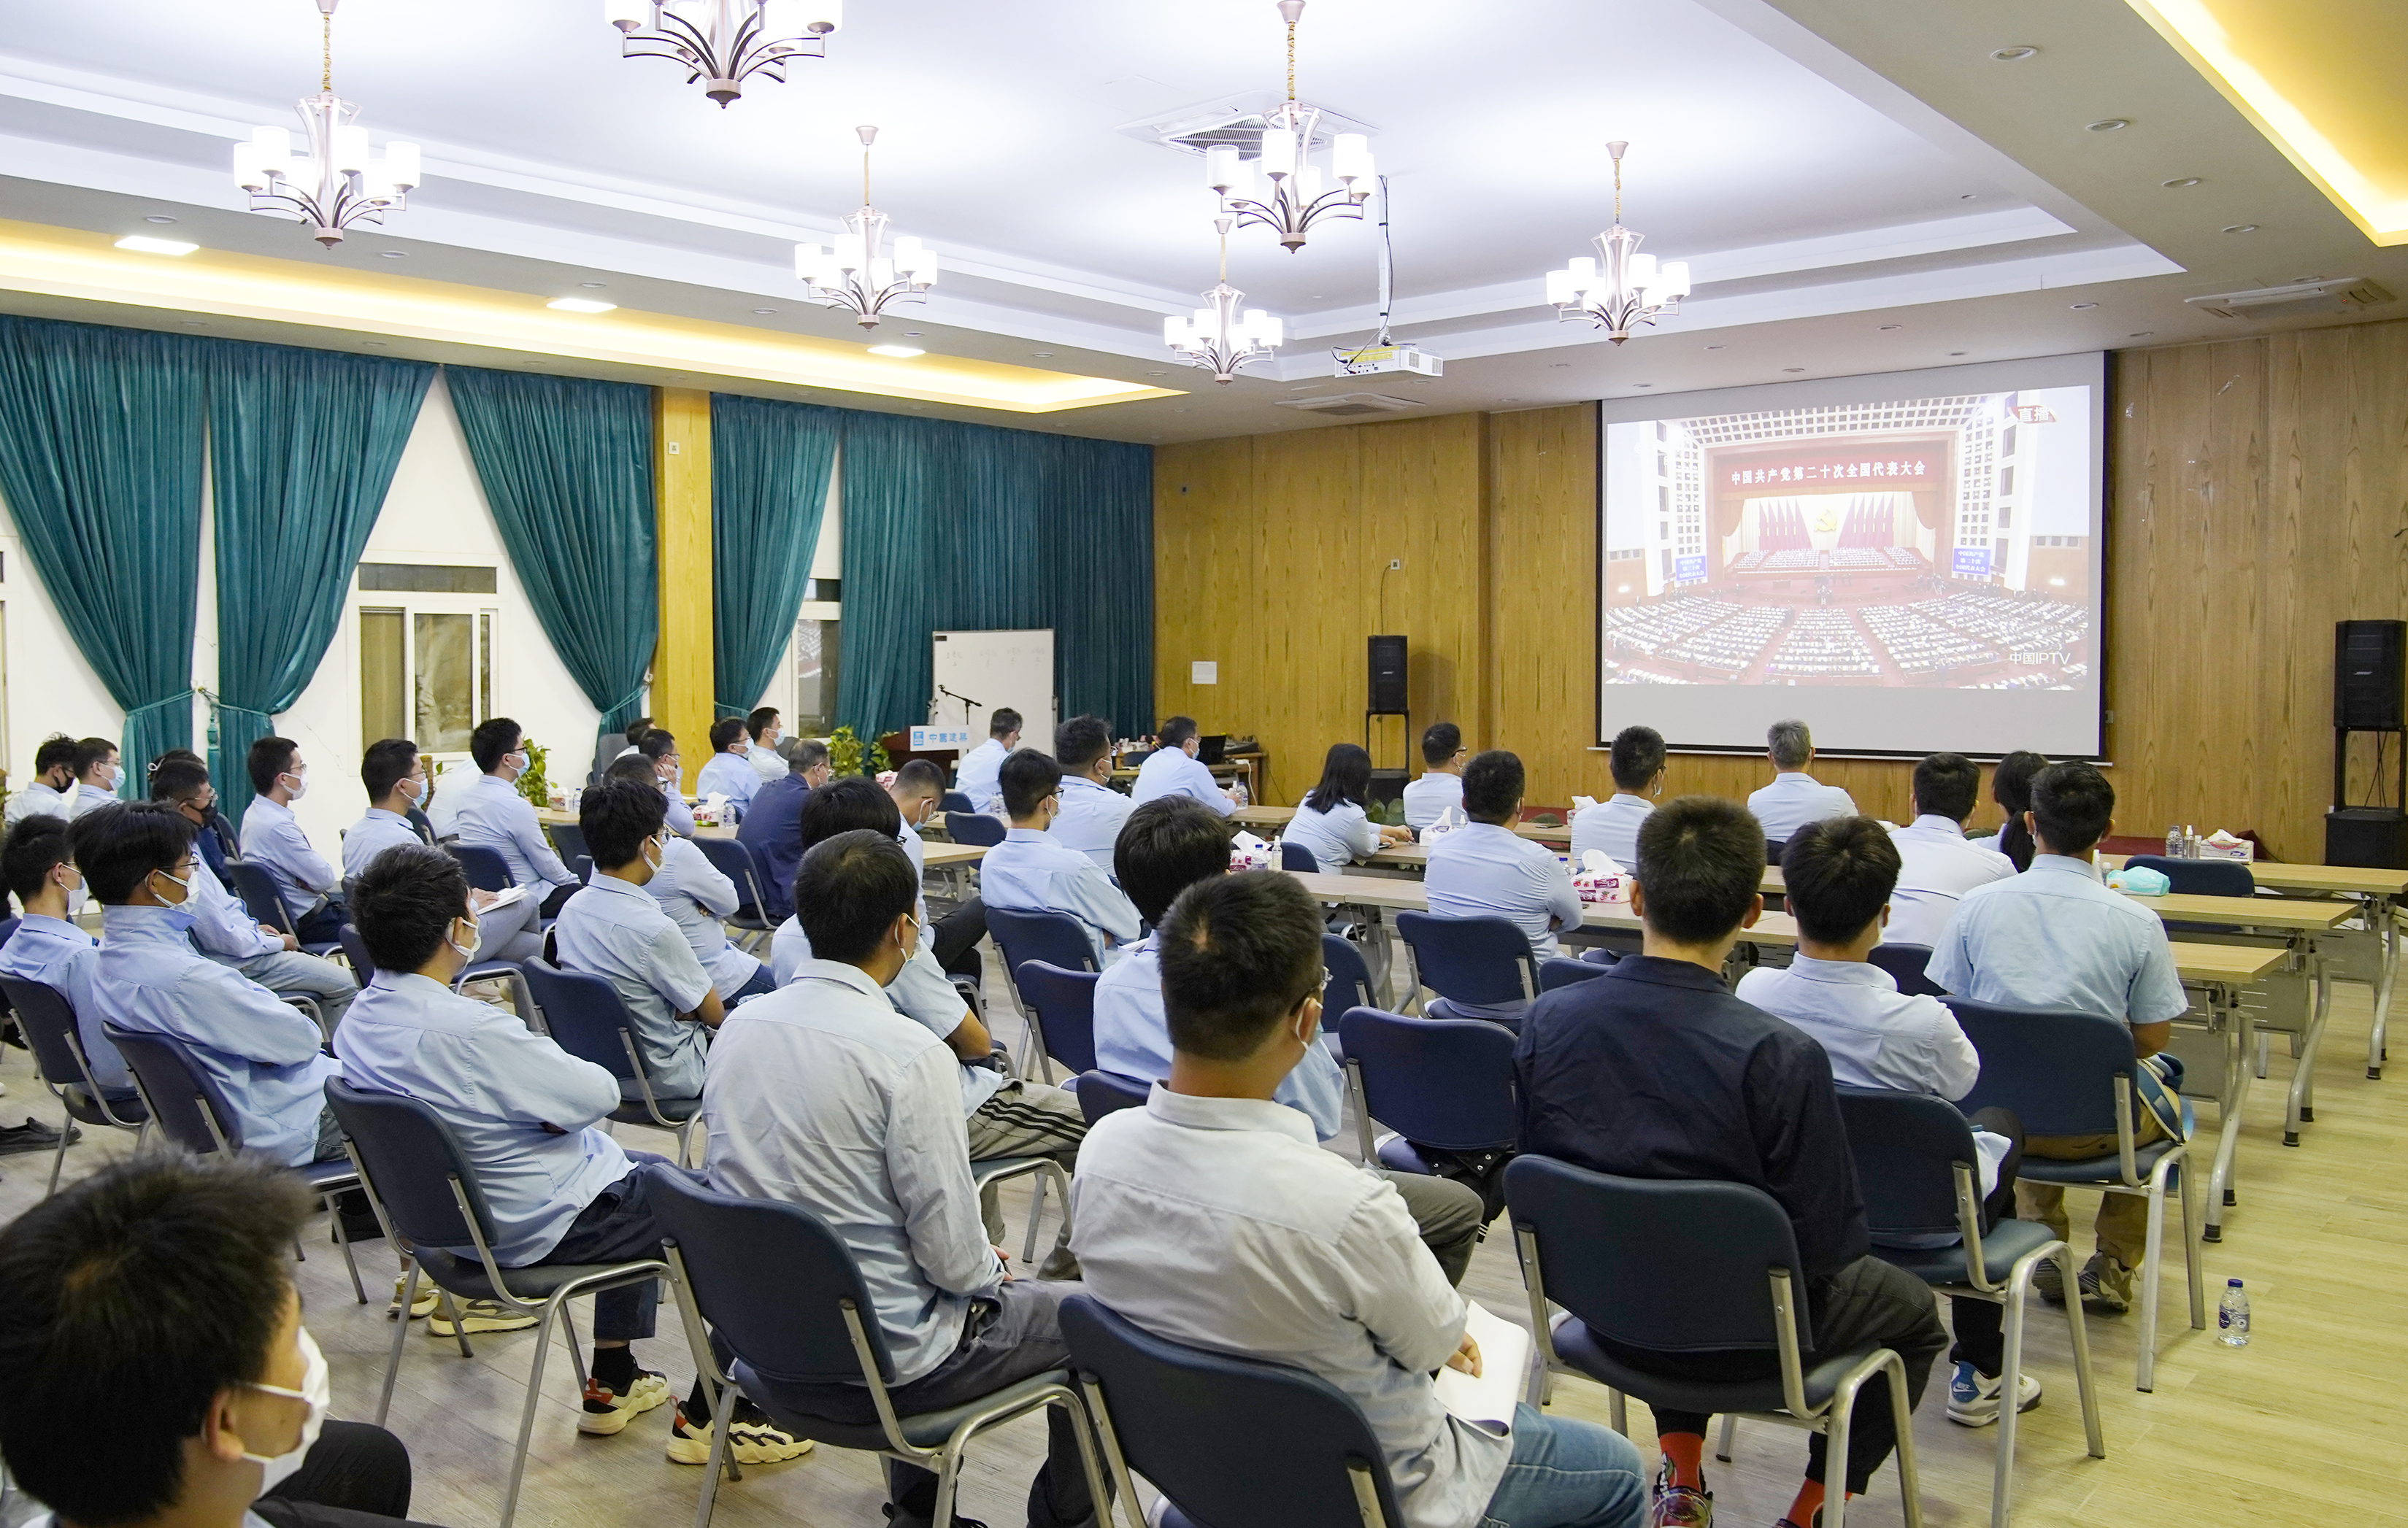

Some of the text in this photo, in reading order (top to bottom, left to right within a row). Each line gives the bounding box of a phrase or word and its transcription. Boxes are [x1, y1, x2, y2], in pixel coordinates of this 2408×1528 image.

[2017, 406, 2050, 422] 直播
[1731, 460, 1926, 485] 中国共产党第二十次全国代表大会
[2009, 652, 2071, 665] 中国IPTV
